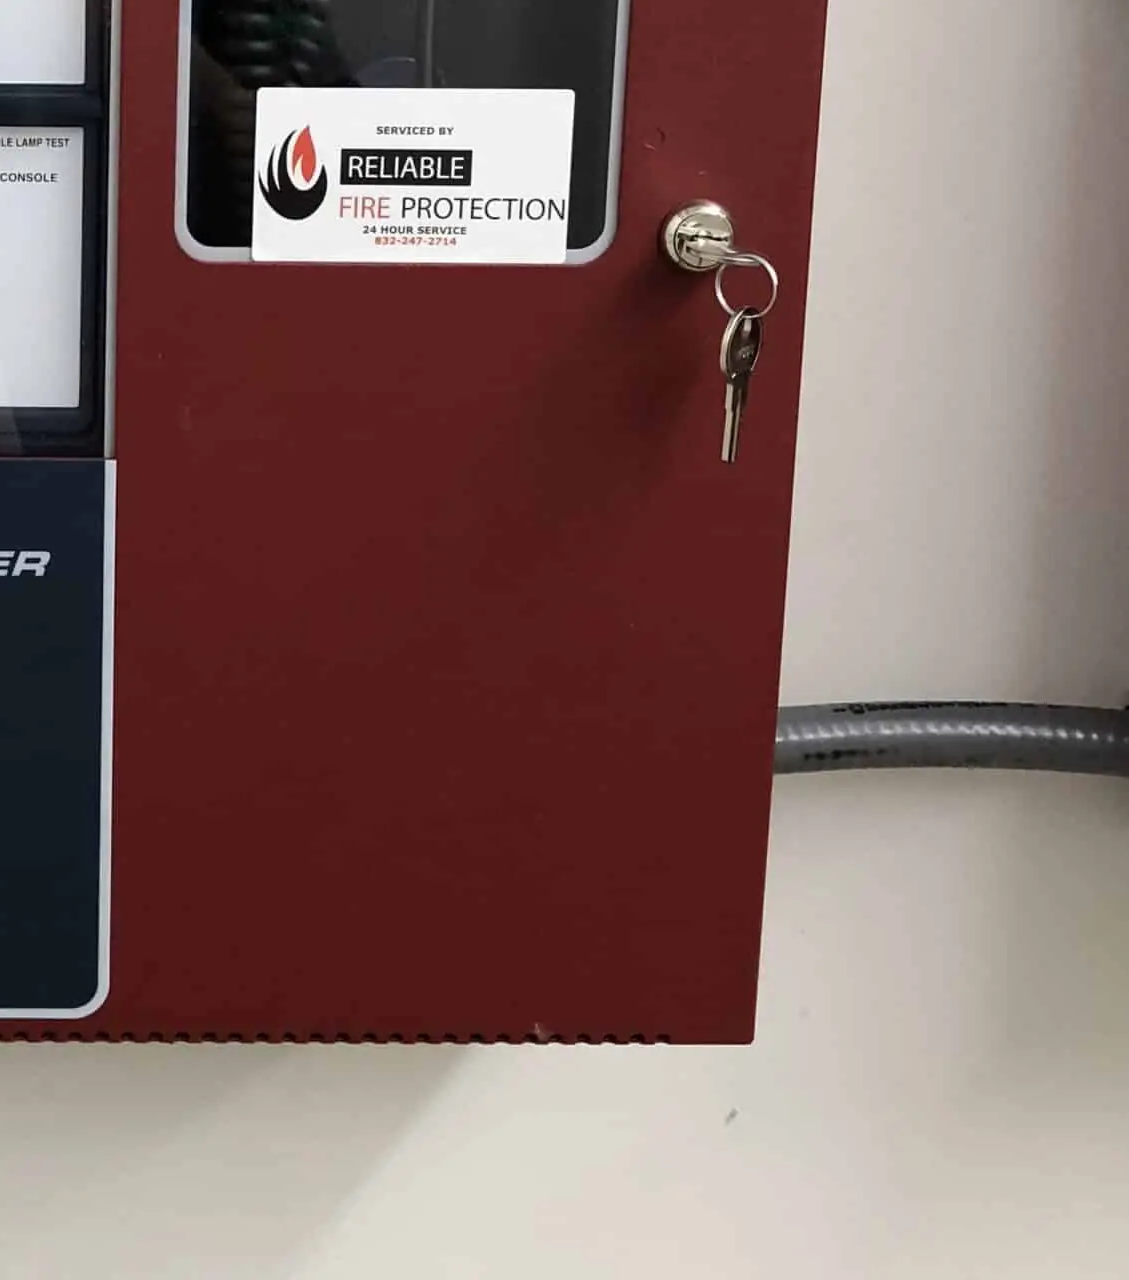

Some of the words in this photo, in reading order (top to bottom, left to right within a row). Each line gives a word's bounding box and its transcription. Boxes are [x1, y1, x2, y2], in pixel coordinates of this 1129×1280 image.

[376, 125, 436, 136] SERVICED
[438, 126, 455, 136] BY
[16, 138, 43, 147] LAMP
[45, 137, 71, 148] TEST
[349, 156, 464, 179] RELIABLE
[0, 172, 59, 183] CONSOLE
[340, 197, 390, 218] FIRE
[402, 197, 565, 220] PROTECTION
[363, 225, 377, 234] 24
[380, 226, 414, 235] HOUR
[417, 226, 467, 235] SERVICE
[374, 236, 457, 247] 832-247-2714
